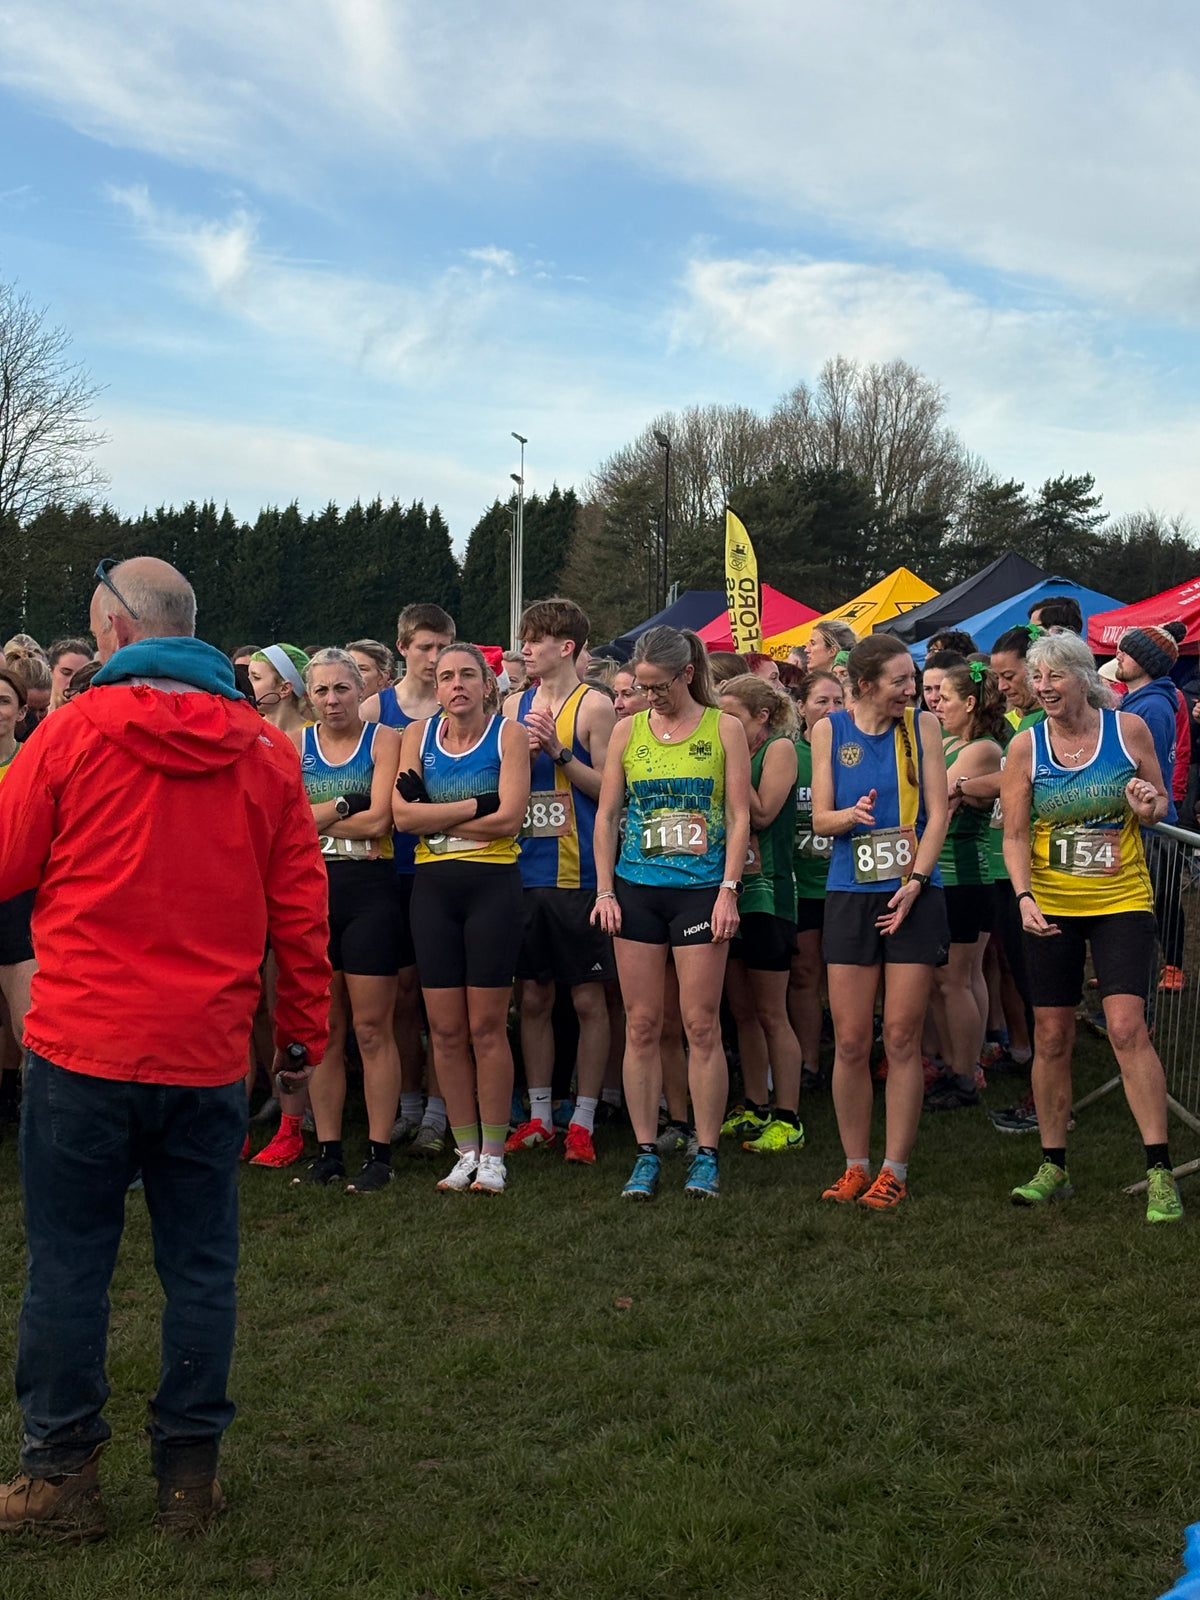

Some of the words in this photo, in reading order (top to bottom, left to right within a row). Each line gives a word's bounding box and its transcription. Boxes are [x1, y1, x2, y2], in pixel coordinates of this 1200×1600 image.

[643, 823, 703, 849] 1112
[798, 831, 834, 851] 76
[857, 839, 912, 872] 858
[1056, 839, 1115, 868] 154
[683, 921, 710, 937] HOKA
